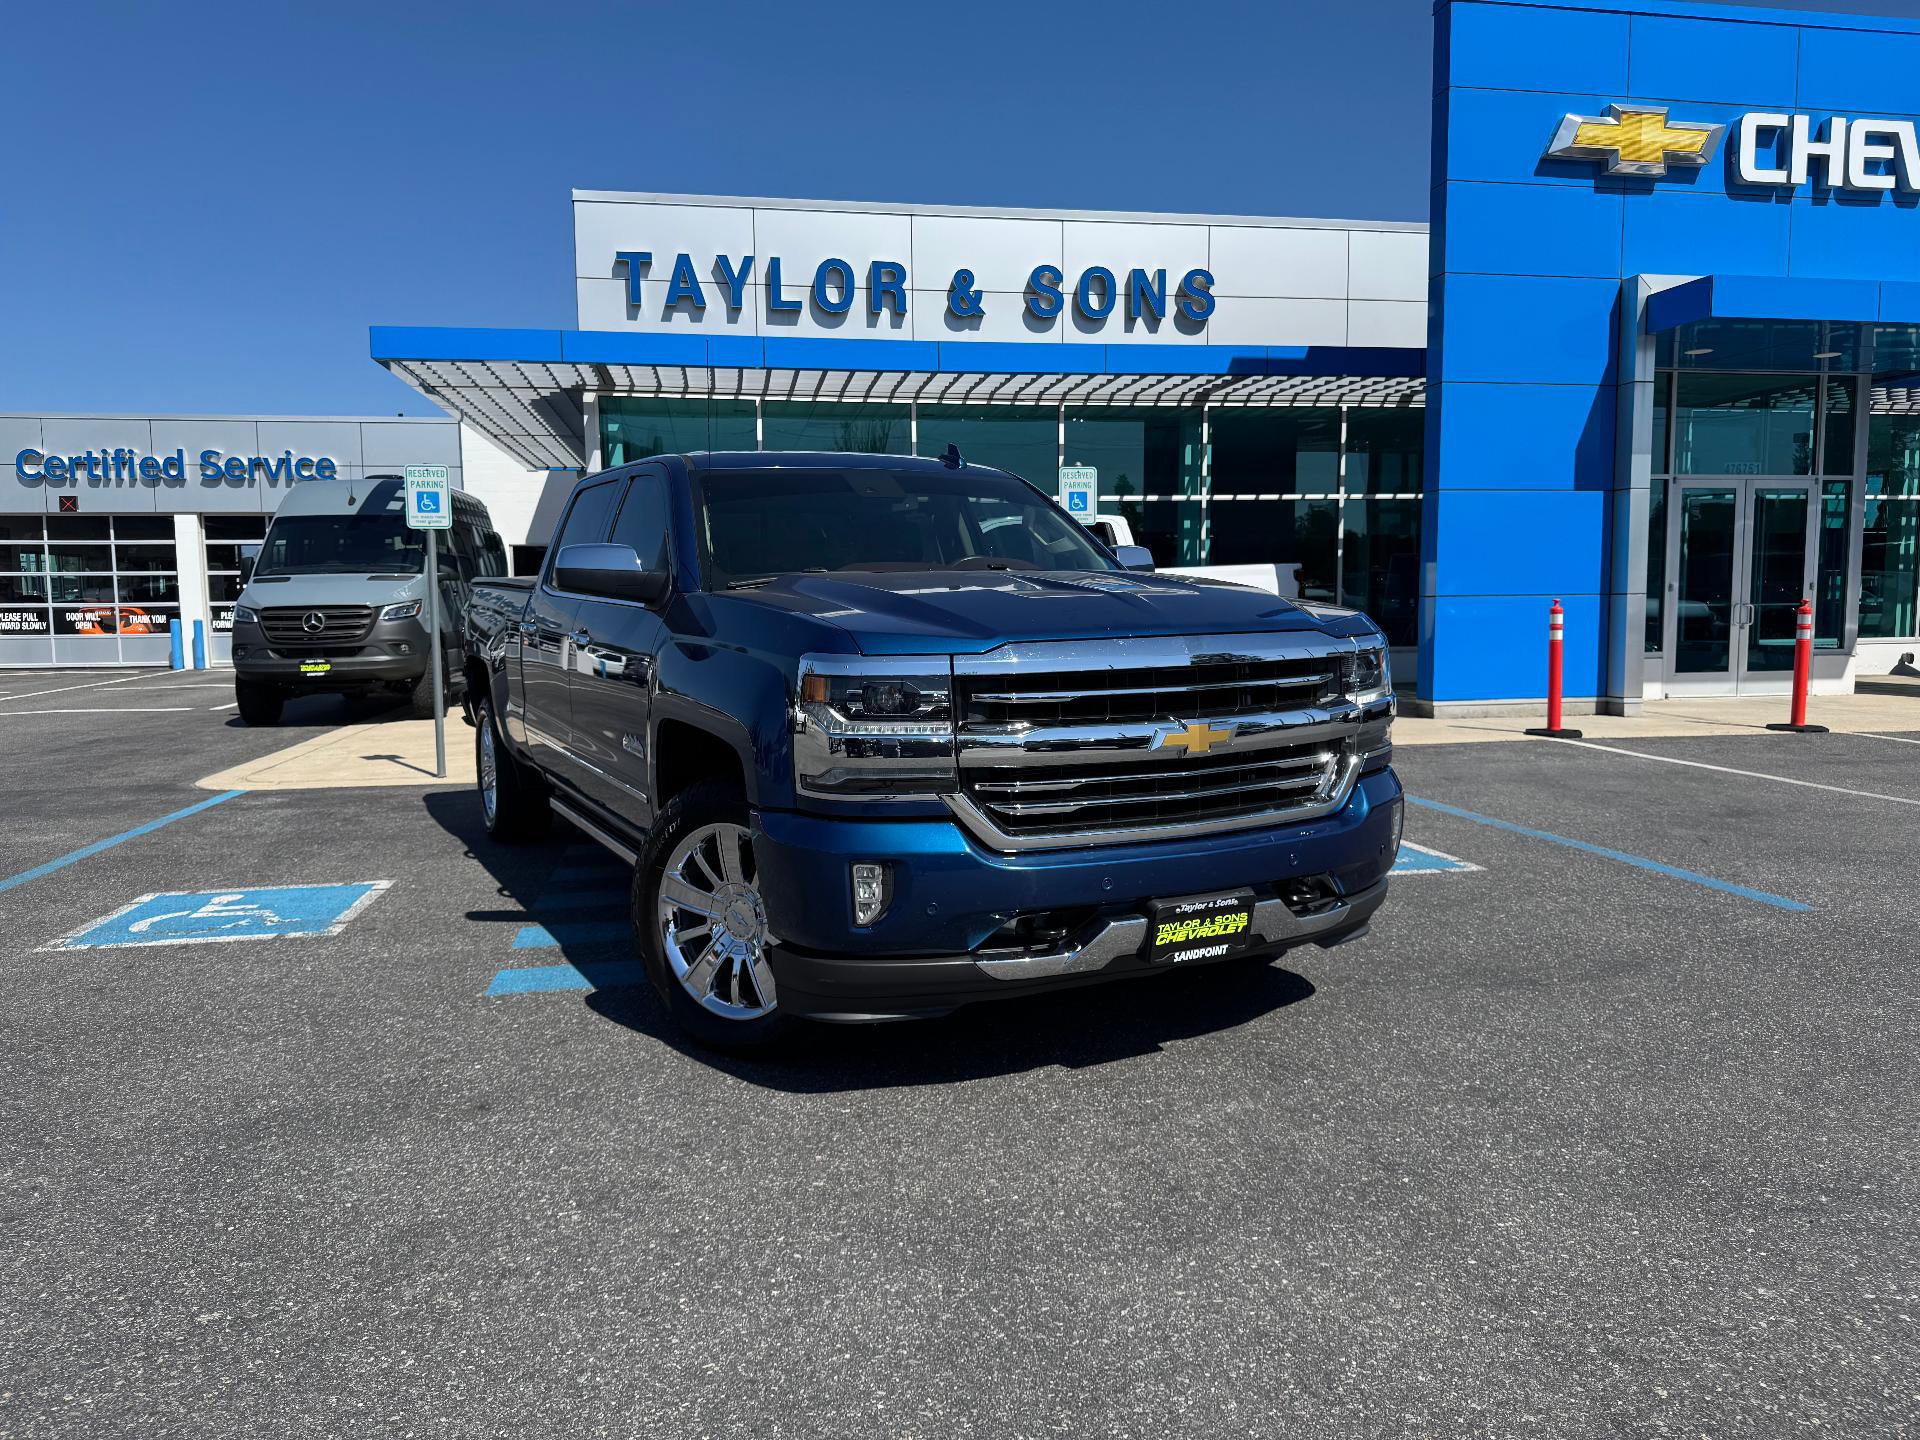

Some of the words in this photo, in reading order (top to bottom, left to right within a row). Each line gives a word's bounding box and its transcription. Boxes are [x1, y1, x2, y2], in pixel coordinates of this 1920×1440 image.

[615, 250, 908, 316] TAYLOR
[949, 268, 986, 317] &
[1028, 264, 1216, 321] SONS
[15, 448, 186, 480] Certified
[200, 449, 337, 480] Service
[408, 469, 445, 478] RESERVED
[1062, 471, 1094, 480] RESERVED
[410, 480, 444, 489] PARKING
[1063, 481, 1092, 489] PARKING
[22, 612, 39, 622] PULL
[66, 612, 84, 622] DOOR
[129, 614, 150, 624] THANK
[152, 614, 167, 624] YOU!
[21, 621, 47, 631] SLOWLY
[75, 621, 93, 631] OPEN
[1180, 902, 1208, 913] Taylor
[1214, 898, 1236, 908] Sons
[1157, 918, 1201, 934] TAYLOR
[1203, 917, 1212, 928] &
[1214, 912, 1248, 925] SONS
[1155, 922, 1248, 946] CHEVROLET
[1173, 944, 1229, 963] SANDPOINT
